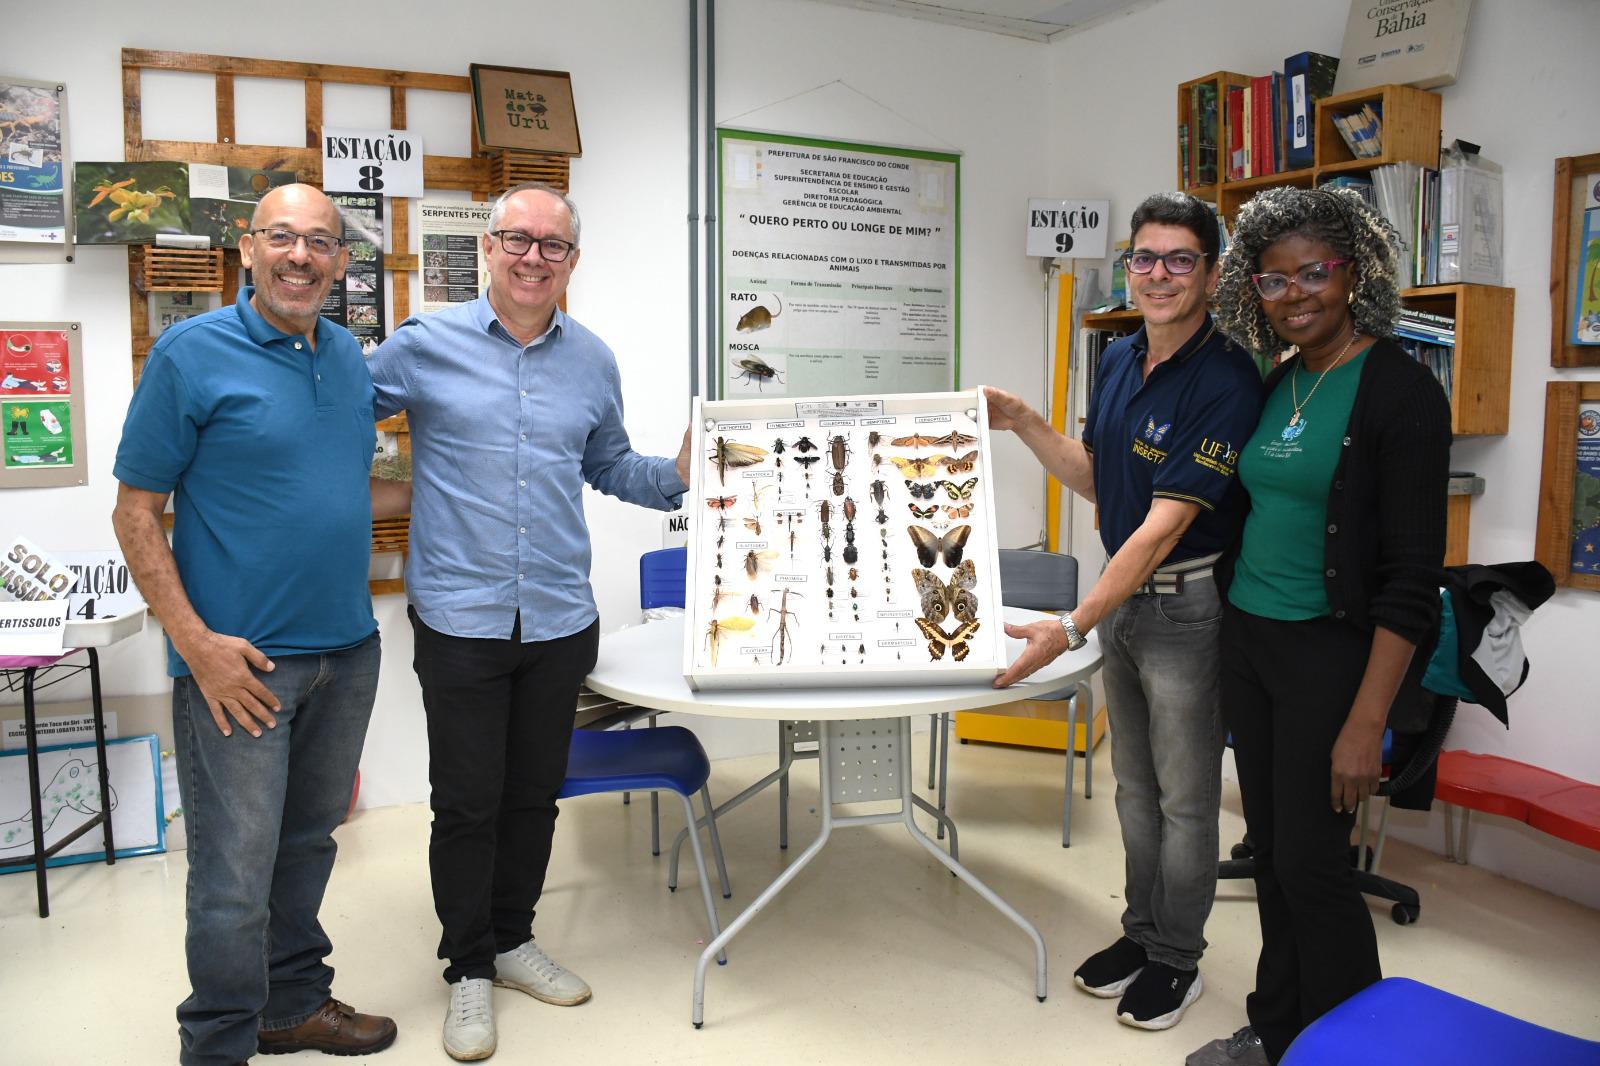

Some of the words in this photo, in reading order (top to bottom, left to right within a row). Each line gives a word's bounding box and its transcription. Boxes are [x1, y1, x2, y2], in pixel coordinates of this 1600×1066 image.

[1376, 10, 1427, 38] Bahia
[504, 88, 547, 102] Mata
[326, 134, 412, 166] ESTAÇÃO
[768, 149, 810, 160] PREFEITURA
[823, 154, 836, 163] SÃO
[838, 156, 876, 166] FRANCISCO
[877, 160, 887, 168] DO
[888, 162, 909, 170] CONDE
[358, 165, 384, 191] 8
[774, 174, 842, 187] SUPERINTENDÊNCIA
[853, 182, 878, 190] ENSINO
[885, 184, 910, 193] GESTÃO
[800, 168, 841, 178] SECRETARIA
[853, 174, 888, 183] EDUCAÇÃO
[329, 195, 377, 207] xicas
[803, 193, 839, 202] DIRETORIA
[829, 187, 859, 196] ESCOLAR
[422, 209, 470, 219] SERPENTES
[829, 203, 865, 212] EDUCAÇÃO
[866, 206, 902, 215] AMBIENTAL
[749, 214, 789, 226] QUERO
[793, 218, 828, 229] PERTO
[832, 221, 848, 231] OU
[851, 222, 886, 234] LONGE
[889, 225, 903, 235] DE
[906, 226, 932, 237] MIM?
[1031, 206, 1099, 233] ESTAÇÃO
[1055, 232, 1074, 253] 9
[732, 250, 769, 259] DOENÇAS
[771, 252, 829, 262] RELACIONADAS
[880, 259, 931, 269] TRANSMITIDAS
[829, 264, 860, 272] ANIMAIS
[730, 293, 757, 301] RATO
[729, 343, 760, 351] MOSCA
[8, 544, 69, 593] SOLO
[65, 559, 129, 600] TAÇÃO
